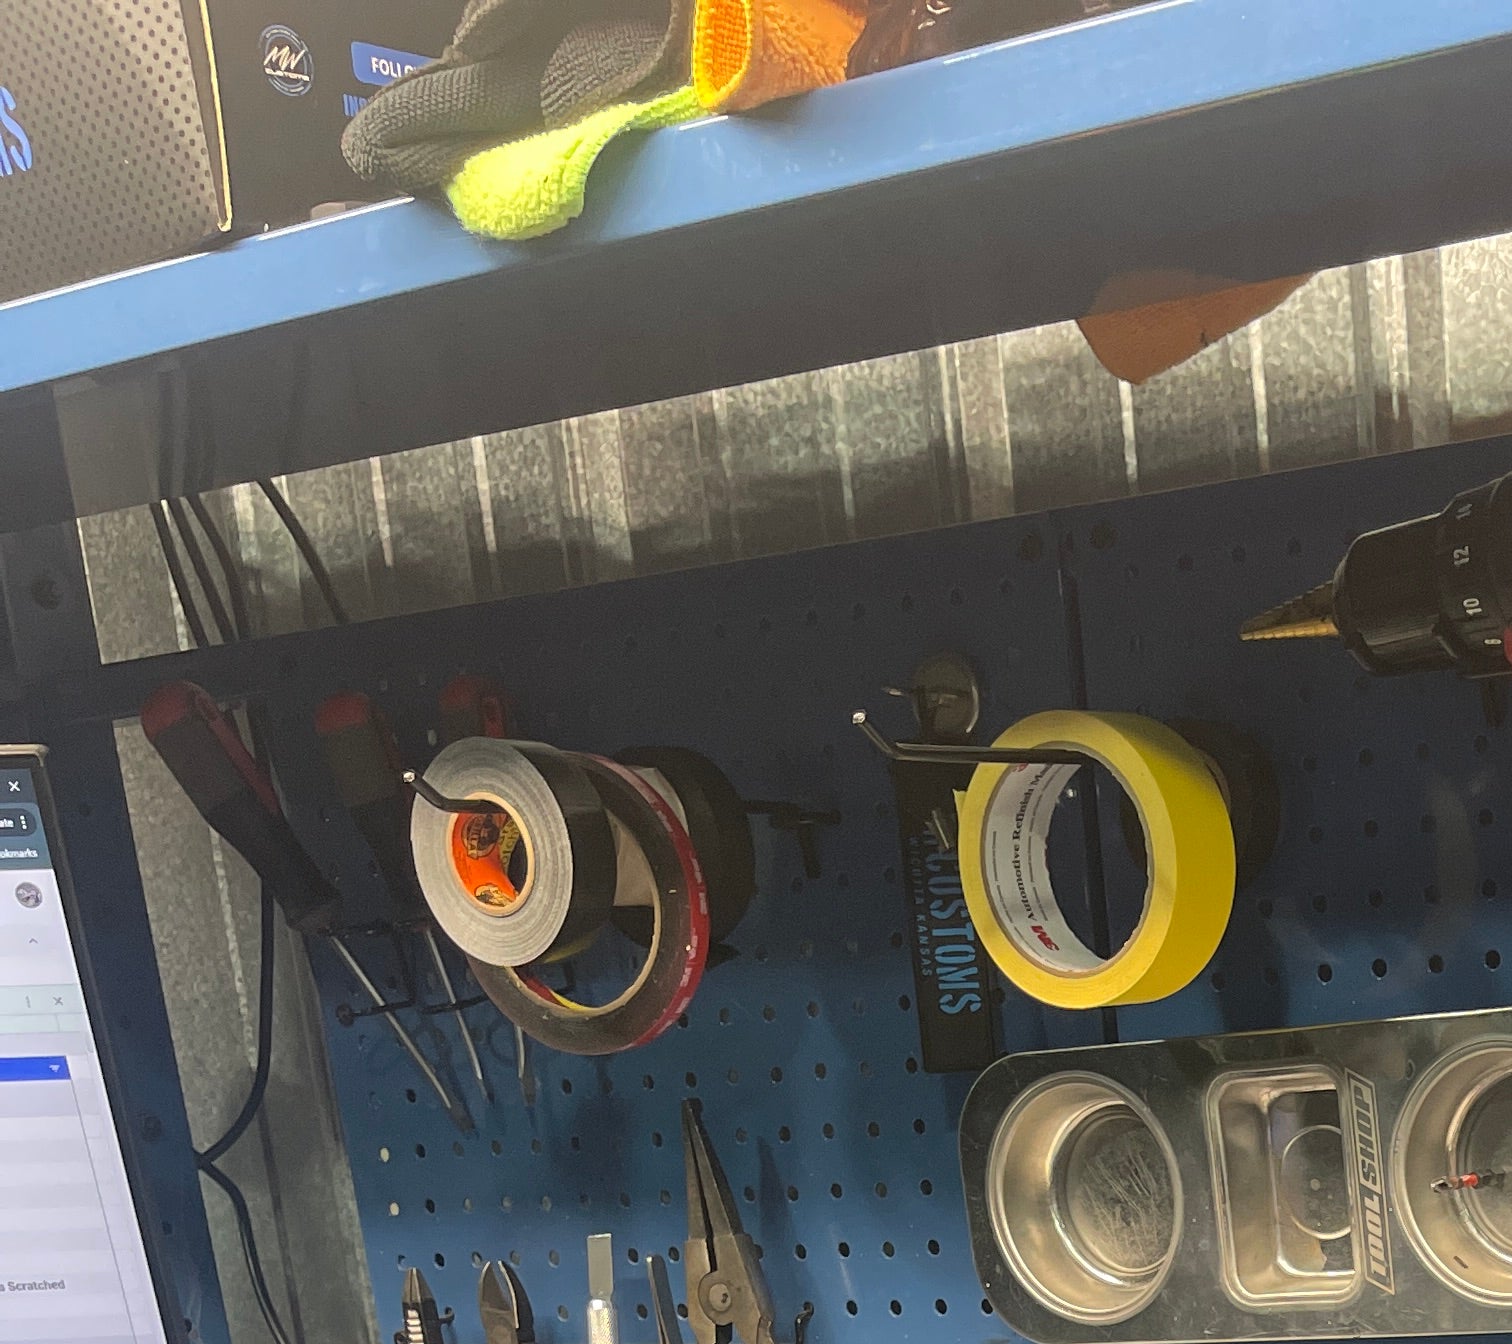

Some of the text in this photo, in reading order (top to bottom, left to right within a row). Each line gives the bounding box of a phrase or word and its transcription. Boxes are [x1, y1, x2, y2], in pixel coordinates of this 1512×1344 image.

[1453, 546, 1470, 567] 12
[1463, 598, 1483, 616] 10
[1012, 838, 1036, 921] Automotive
[916, 914, 932, 977] KANSAS
[1031, 924, 1060, 951] 3M
[1353, 1084, 1388, 1288] TOOL SHOP
[8, 1280, 66, 1291] Scratched
